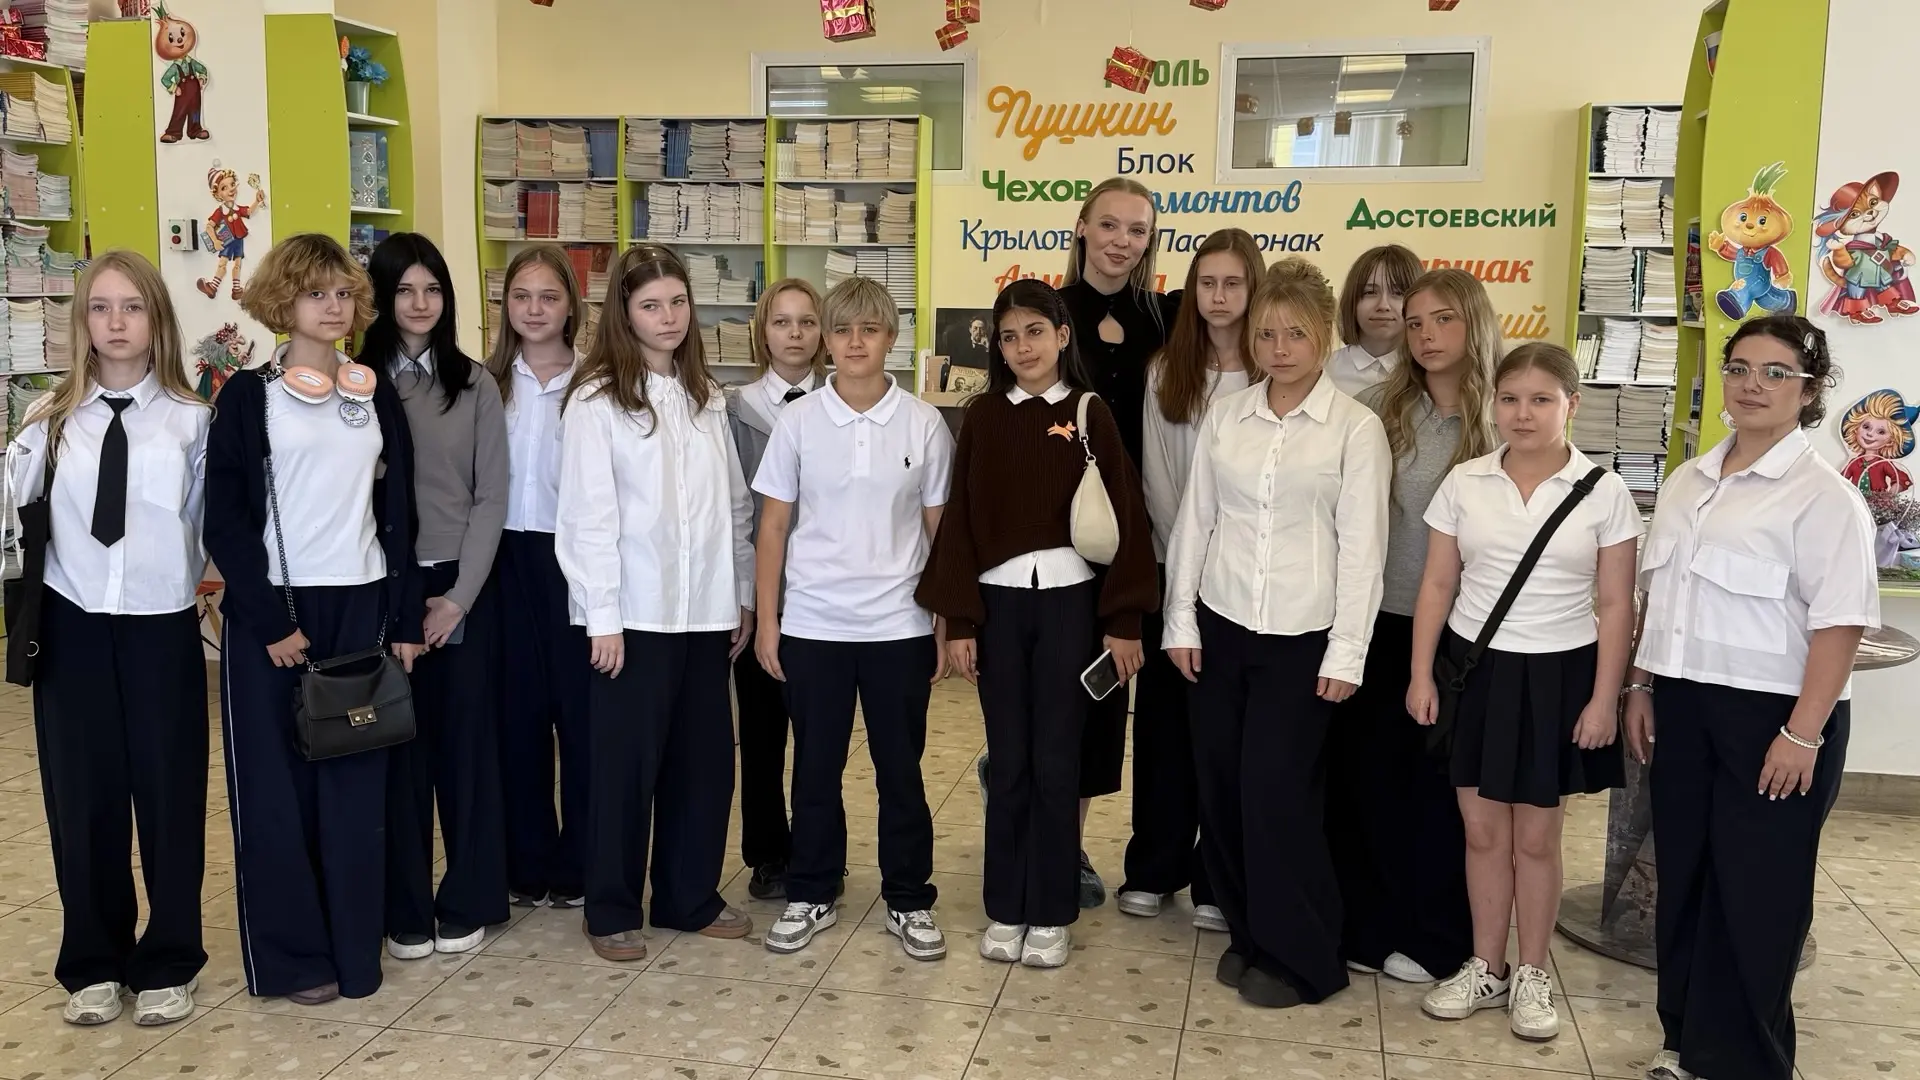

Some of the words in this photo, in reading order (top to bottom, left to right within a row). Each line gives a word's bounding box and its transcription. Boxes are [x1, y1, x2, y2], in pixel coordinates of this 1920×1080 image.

[987, 86, 1177, 160] Пушкин
[1117, 147, 1195, 174] Блок
[982, 170, 1093, 202] Чехов
[1151, 180, 1302, 214] монтов
[960, 219, 1074, 262] Крылов
[1157, 229, 1324, 252] Пасрнак
